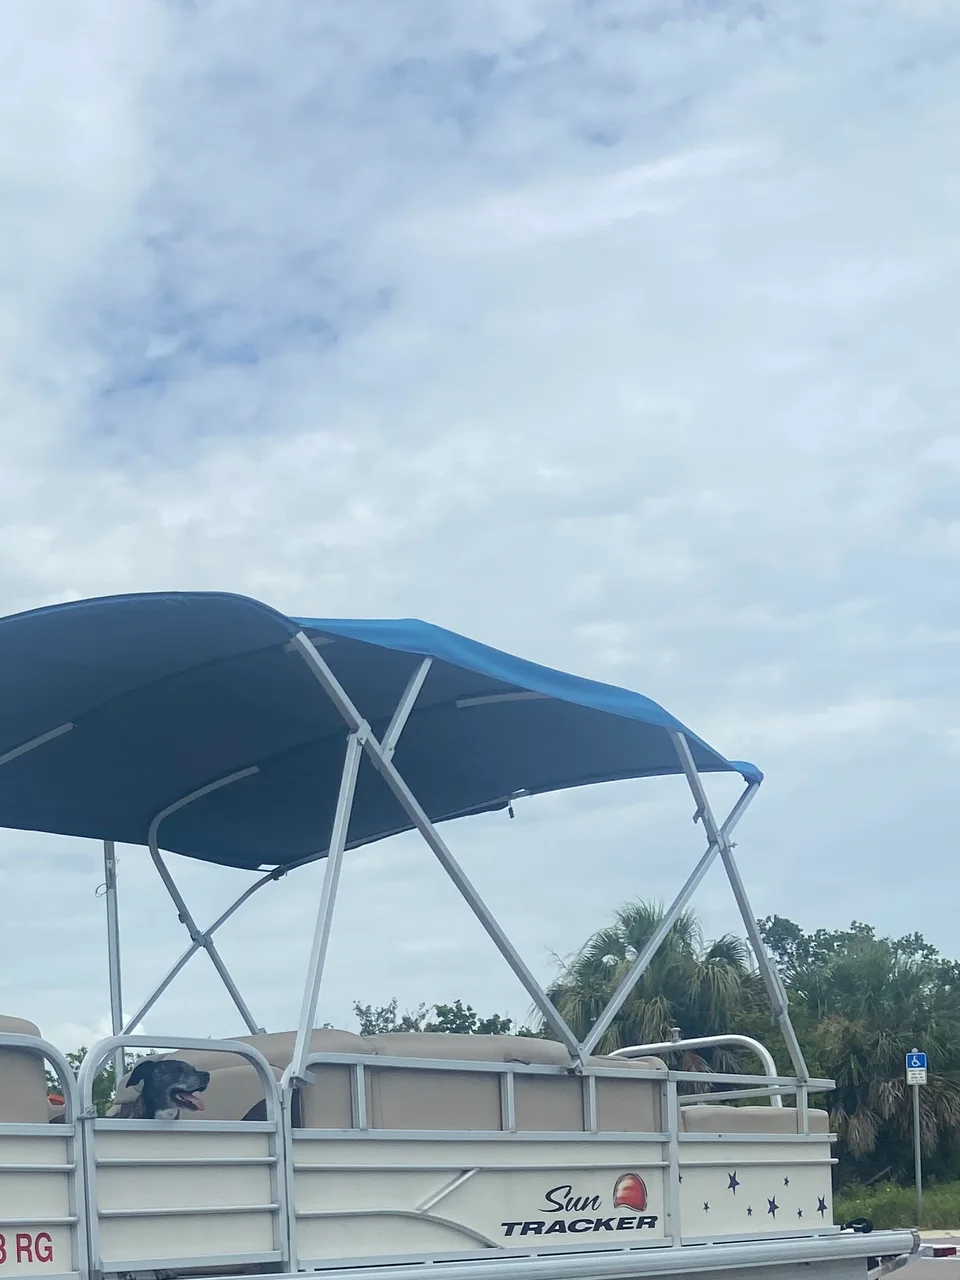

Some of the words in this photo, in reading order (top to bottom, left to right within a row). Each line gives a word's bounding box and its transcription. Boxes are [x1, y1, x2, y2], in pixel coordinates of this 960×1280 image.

[538, 1185, 602, 1213] Sun
[500, 1215, 659, 1237] TRACKER
[15, 1232, 54, 1263] RG
